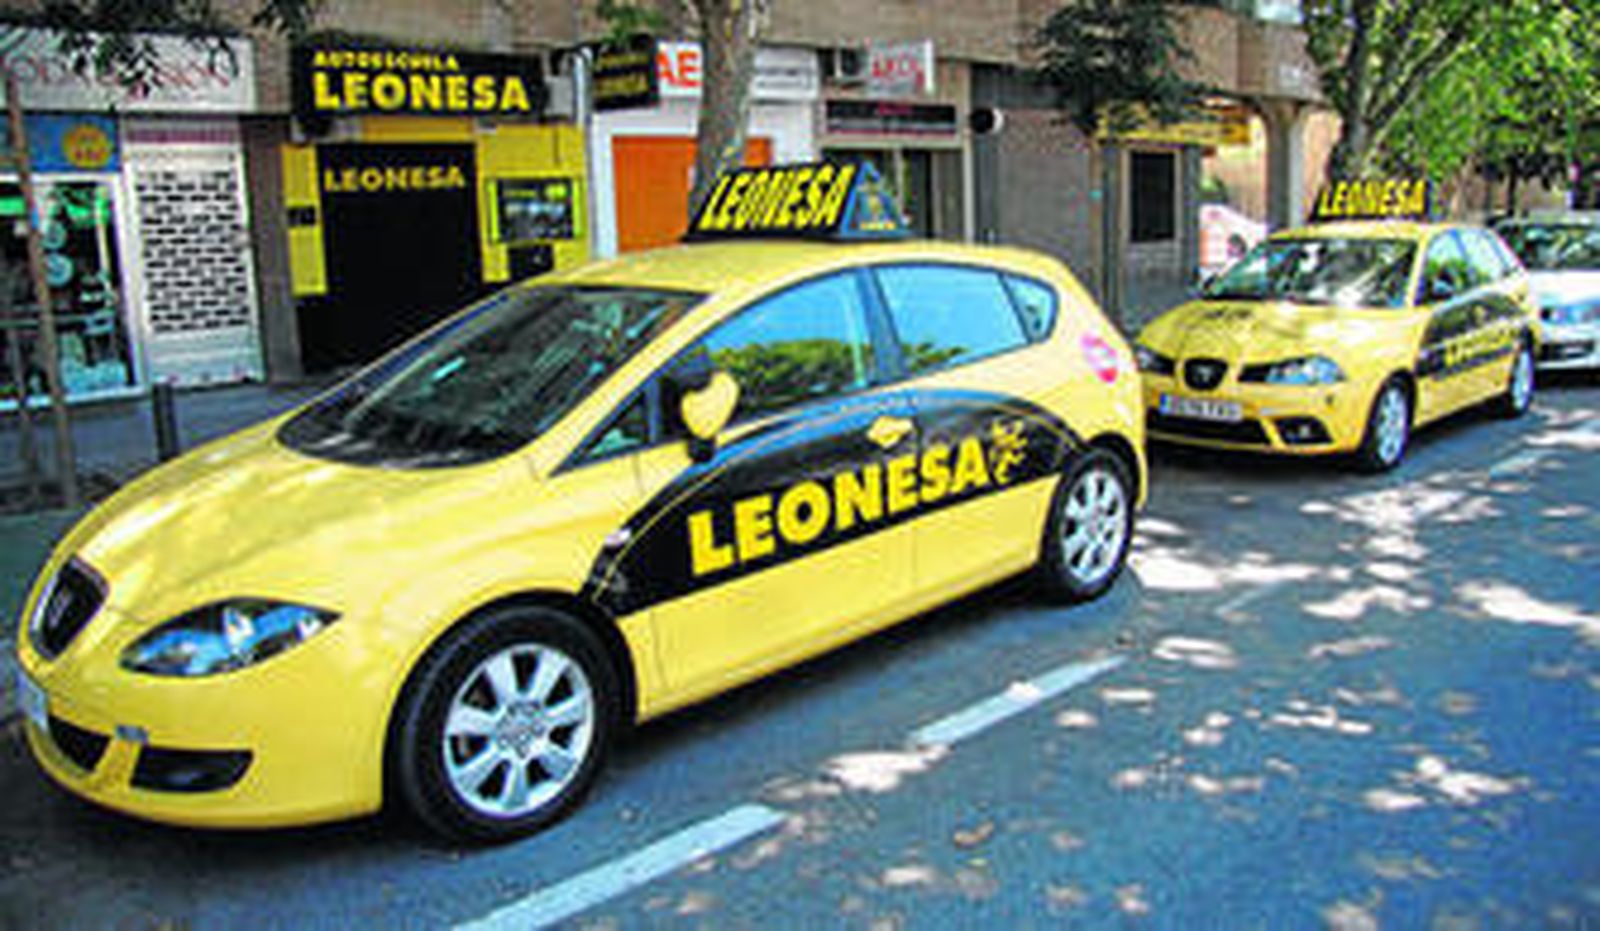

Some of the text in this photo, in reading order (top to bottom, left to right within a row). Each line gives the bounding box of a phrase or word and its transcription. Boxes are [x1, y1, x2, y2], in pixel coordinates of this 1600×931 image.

[313, 72, 531, 111] LEONESA
[323, 165, 466, 193] LEONESA
[699, 163, 856, 231] LEONESA
[1318, 180, 1425, 217] LEONESA
[687, 436, 991, 577] LEONESA
